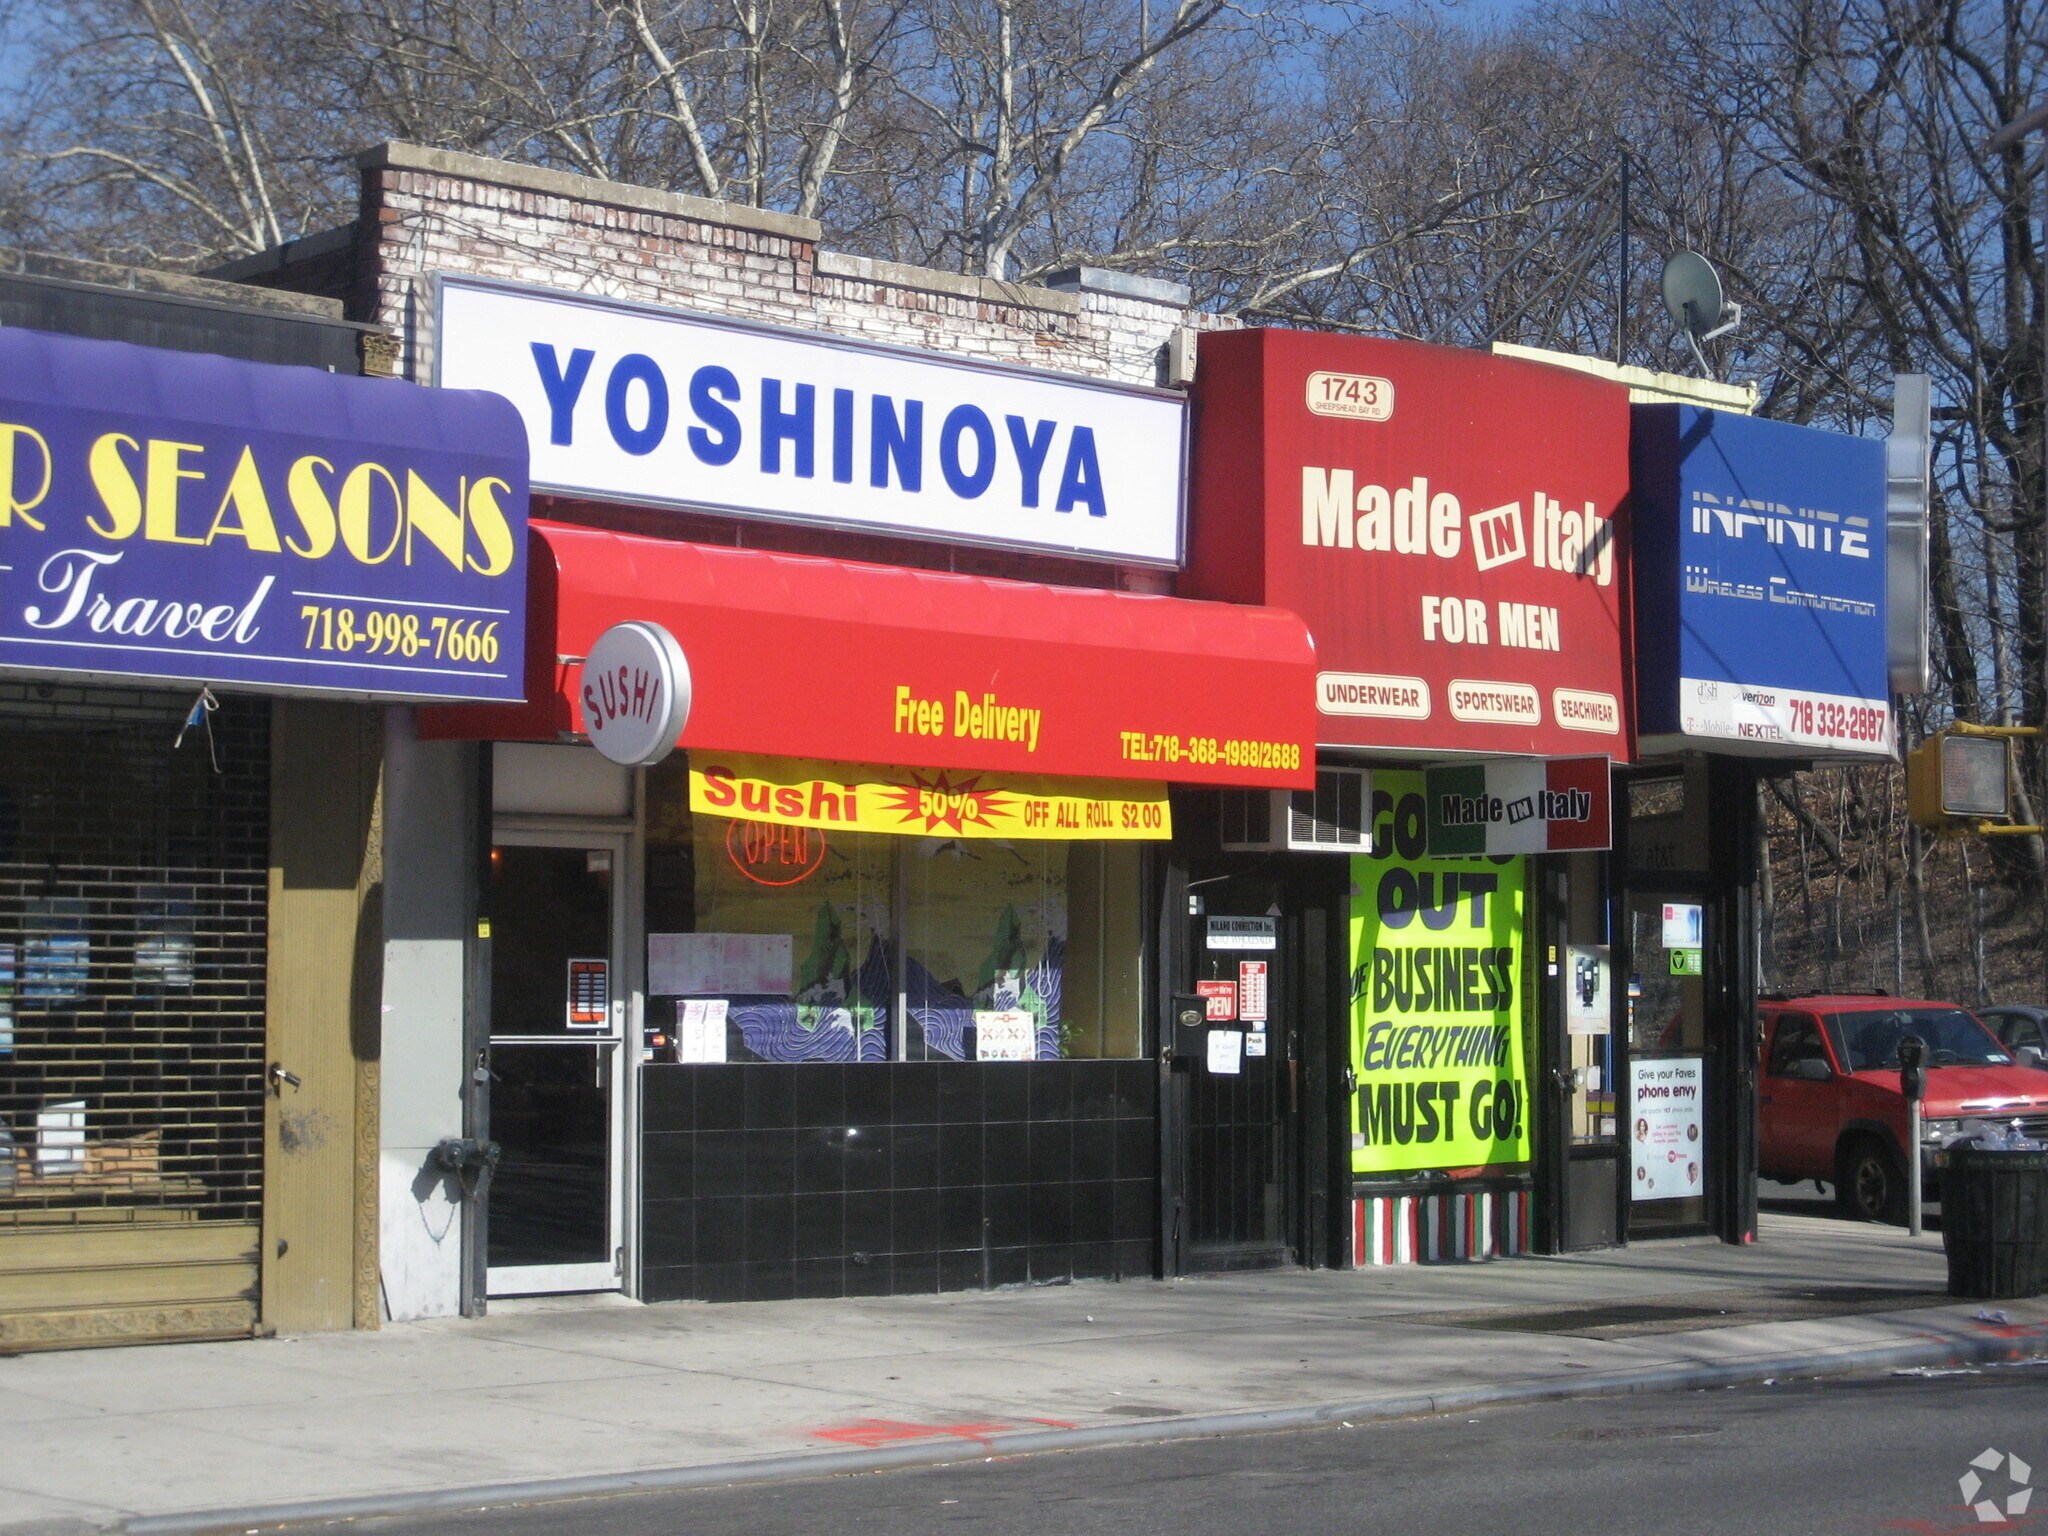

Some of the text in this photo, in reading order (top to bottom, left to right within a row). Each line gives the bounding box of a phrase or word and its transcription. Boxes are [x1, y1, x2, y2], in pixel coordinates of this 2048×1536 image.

[1315, 401, 1357, 413] SHEEPSHEAD
[1359, 406, 1370, 414] BAY
[1322, 377, 1377, 405] 1743
[530, 341, 1107, 518] YOSHINOYA
[87, 432, 515, 577] SEASONS
[1302, 466, 1613, 586] Made IN Italy
[1693, 491, 1869, 558] INFINITE
[24, 548, 275, 644] Travel
[301, 605, 498, 664] 718-998-7666
[1422, 595, 1560, 652] FOR MEN
[584, 665, 661, 730] SUSHI
[895, 685, 1041, 753] Free Delivery
[1325, 683, 1420, 708] UNDERWEAR
[1455, 690, 1535, 715] SPORTSWEAR
[1561, 698, 1613, 723] BEACHWEAR
[1742, 690, 1776, 706] verizon
[1738, 722, 1783, 740] NEXTEL
[1789, 699, 1813, 735] 718
[1817, 702, 1886, 742] 332-2887
[703, 764, 857, 823] Sushi
[918, 785, 978, 821] 50%
[1024, 804, 1049, 829] OFF
[1055, 803, 1080, 829] ALL
[1087, 803, 1113, 829] ROLL
[1441, 793, 1503, 826] Made
[1537, 788, 1592, 823] Italy
[745, 819, 807, 864] OPEN
[1377, 867, 1498, 931] OUT
[1231, 920, 1262, 932] CONNECTION
[1373, 947, 1514, 1013] BUSINESS
[1206, 996, 1232, 1017] PEN
[1363, 1021, 1511, 1071] EVERYTHING
[1637, 1083, 1697, 1103] phone envy
[1638, 1068, 1696, 1082] Give your Faves
[1358, 1079, 1523, 1146] MUST GO!
